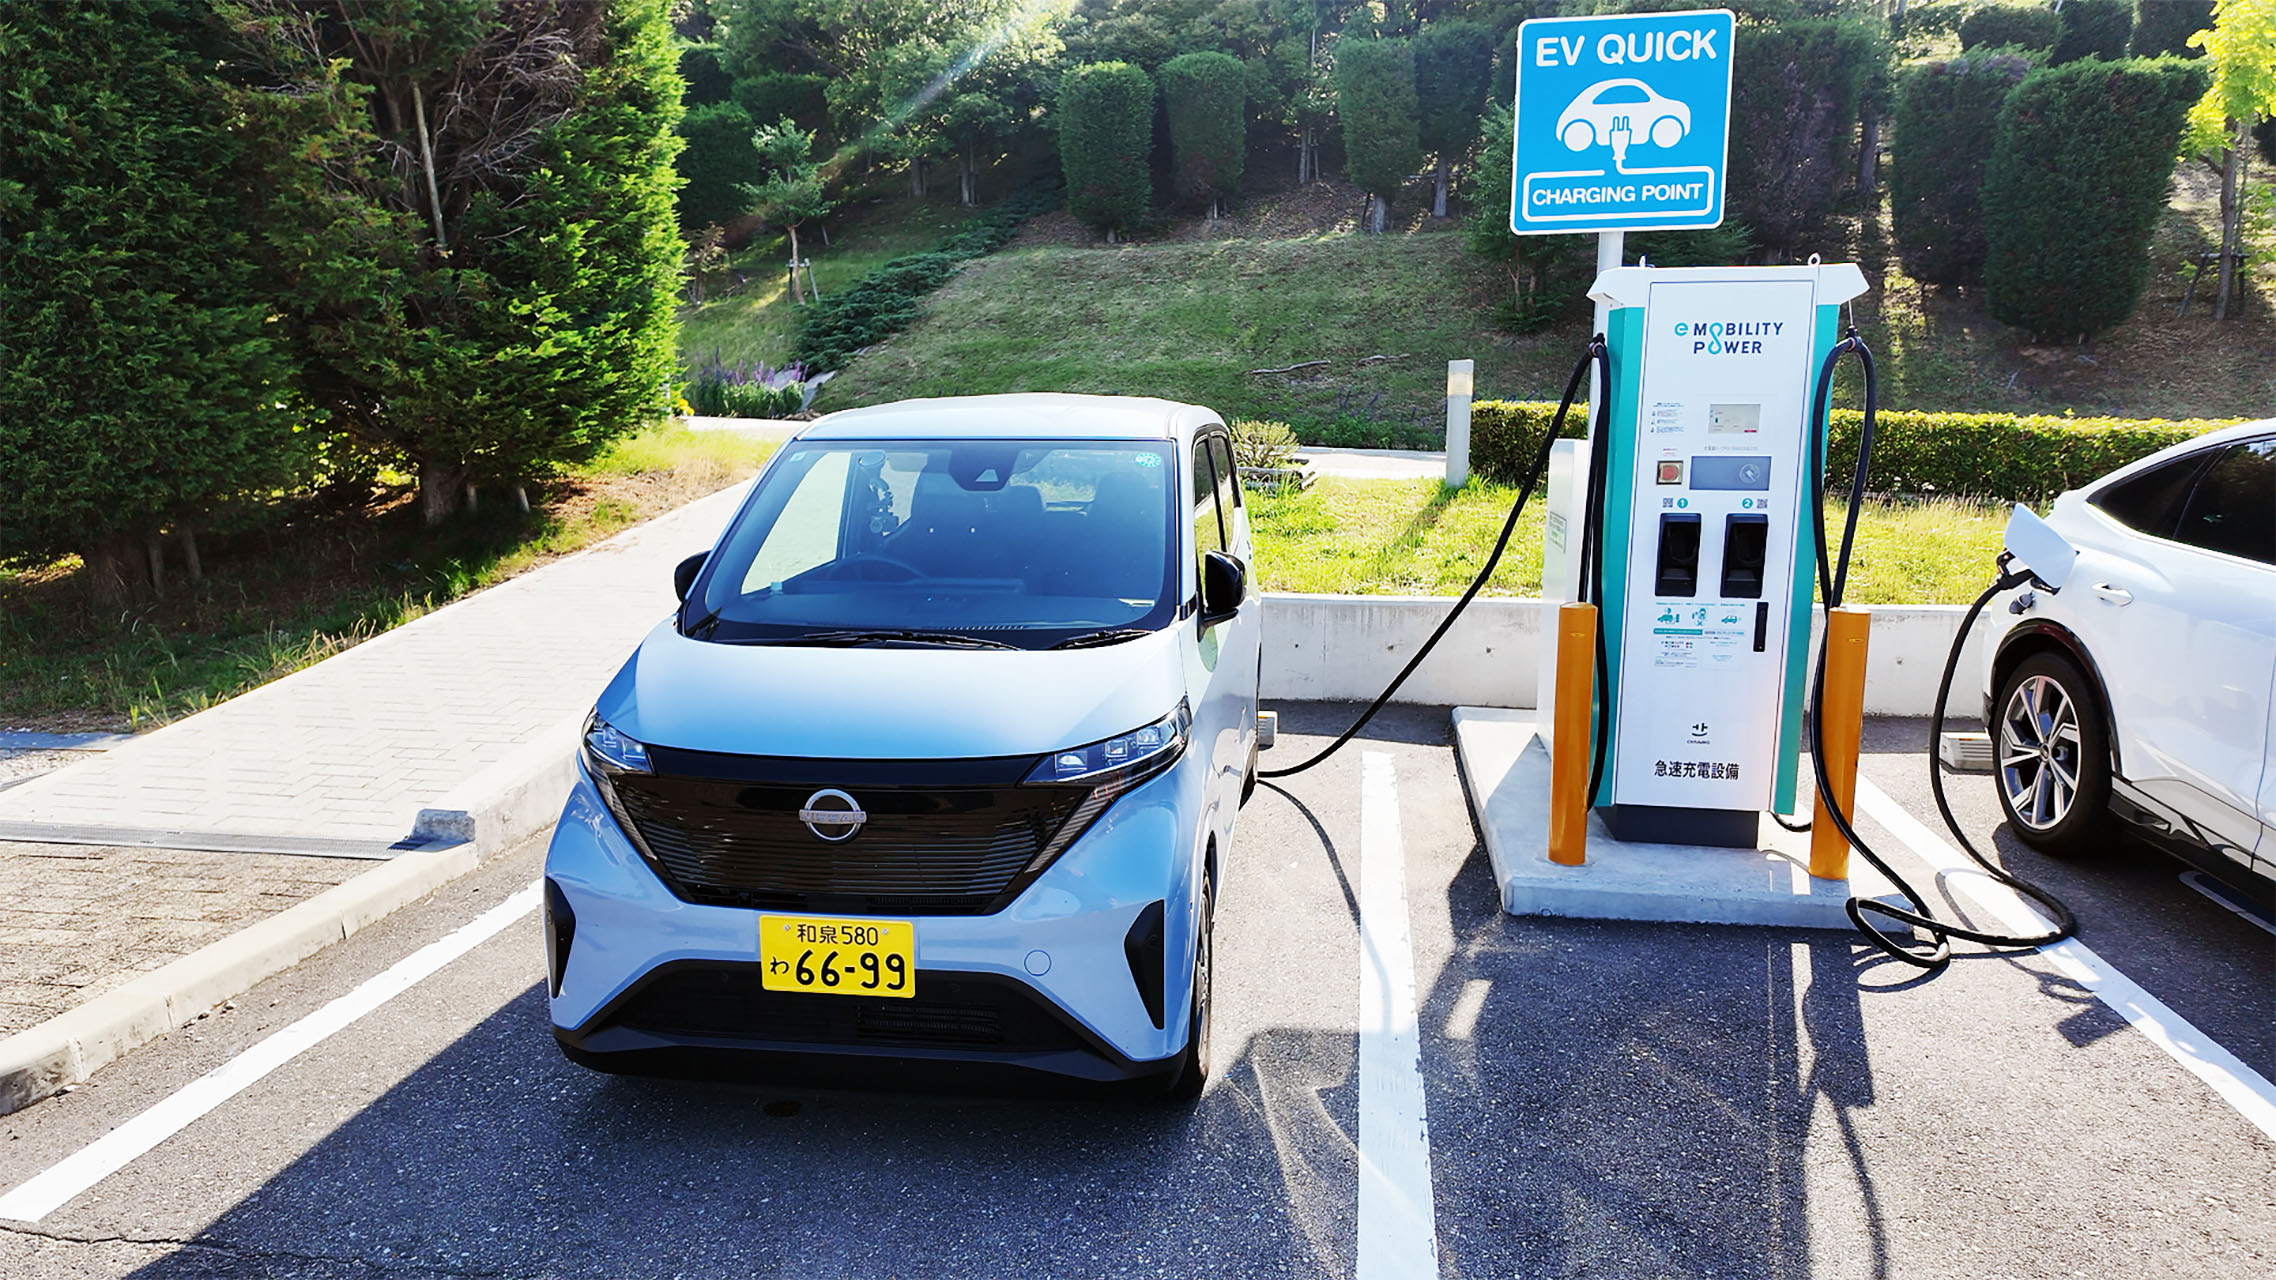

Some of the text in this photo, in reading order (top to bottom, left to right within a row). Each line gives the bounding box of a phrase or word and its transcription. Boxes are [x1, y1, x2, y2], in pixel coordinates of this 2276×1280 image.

[1536, 28, 1717, 67] EV QUICK
[1532, 183, 1704, 206] CHARGING POINT
[1693, 322, 1784, 337] MOBILITY
[1693, 341, 1763, 355] POWER
[1654, 760, 1740, 780] 急速充電設備
[770, 949, 906, 990] わ 66-99
